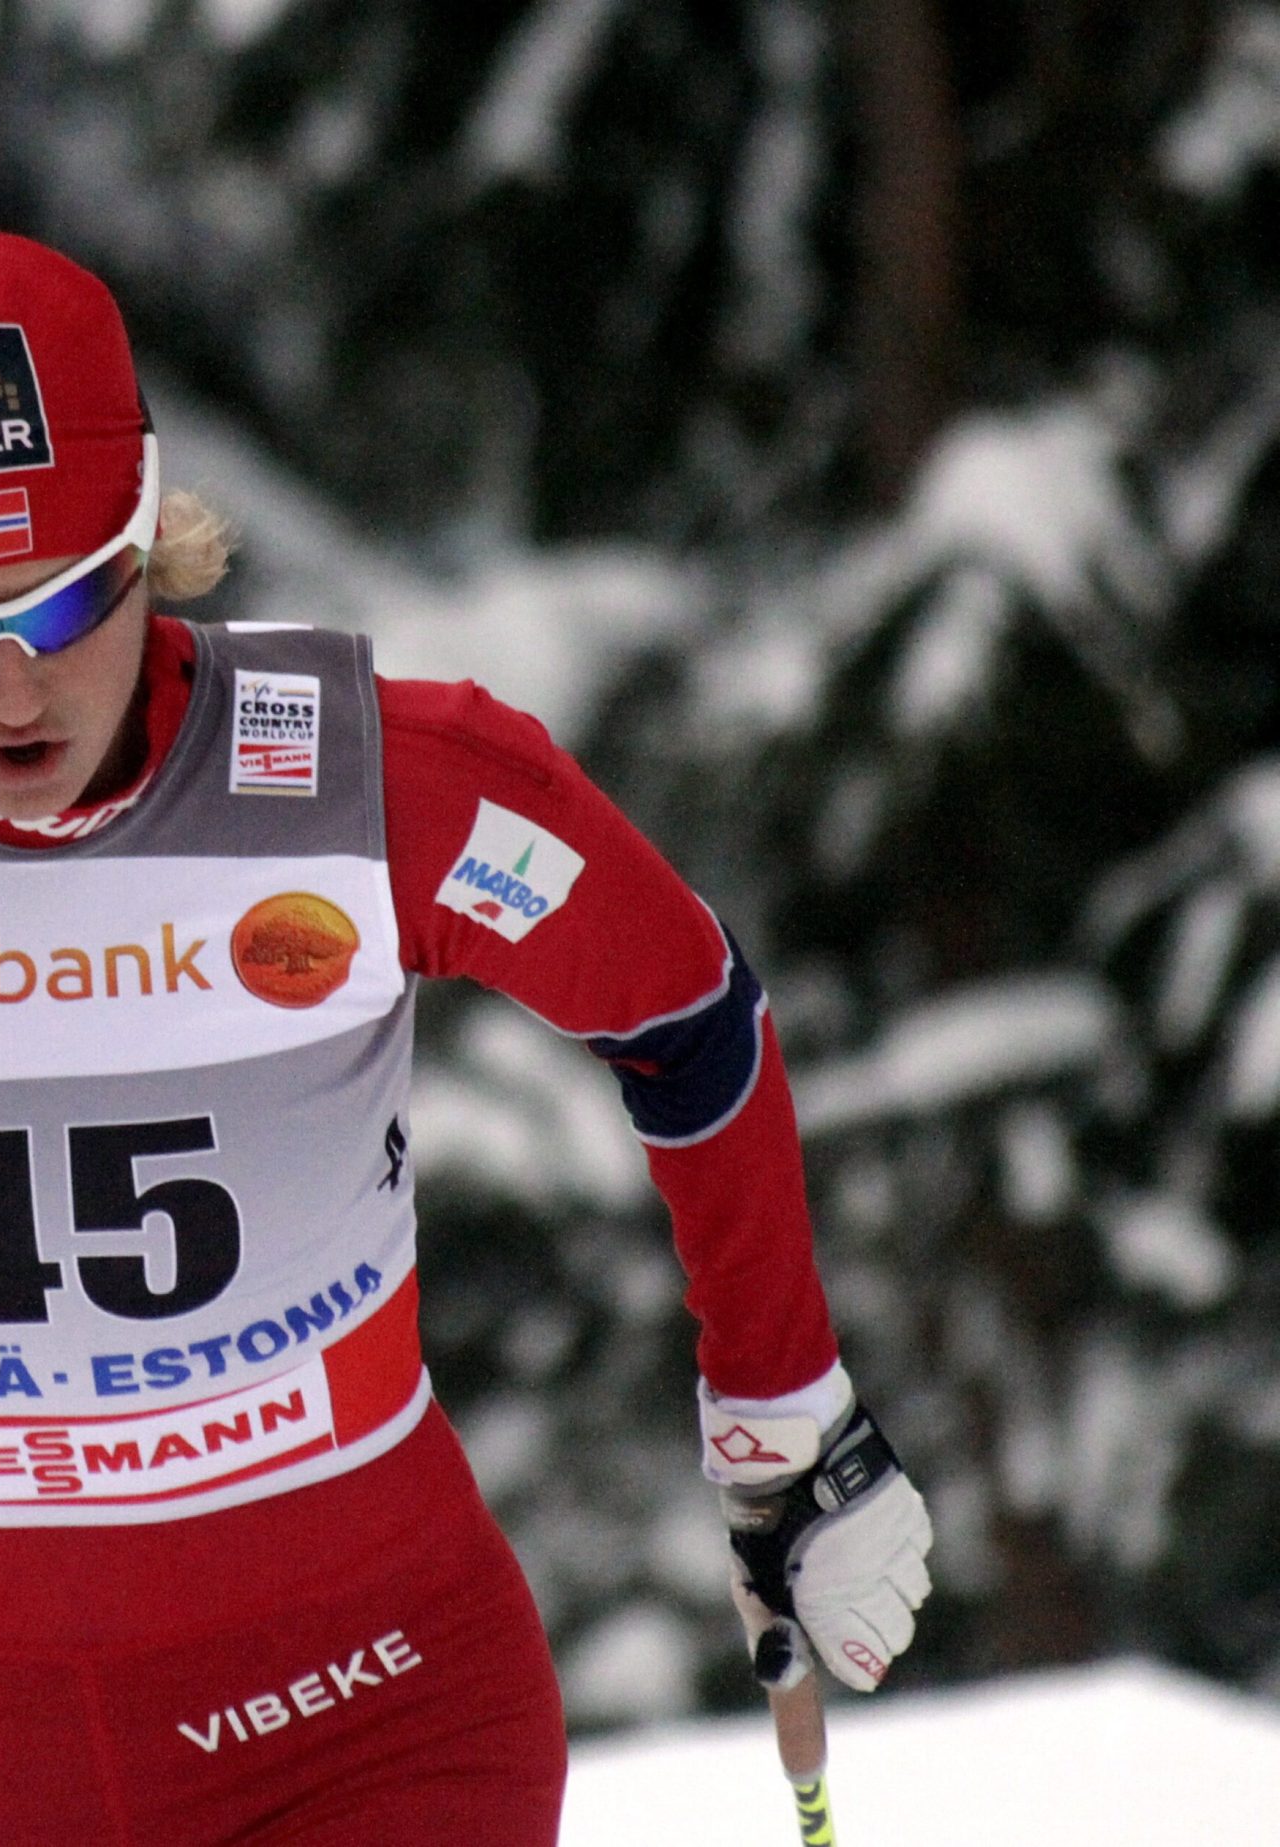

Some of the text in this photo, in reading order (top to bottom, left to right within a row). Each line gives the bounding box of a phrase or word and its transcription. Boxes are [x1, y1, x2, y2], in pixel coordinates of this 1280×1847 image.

[239, 717, 313, 730] COUNTRY
[240, 700, 315, 718] CROSS
[239, 728, 314, 741] WORLD CUP
[451, 856, 549, 919] MAXBO
[90, 1261, 383, 1397] ESTONIA
[176, 1629, 423, 1753] VIBEKE
